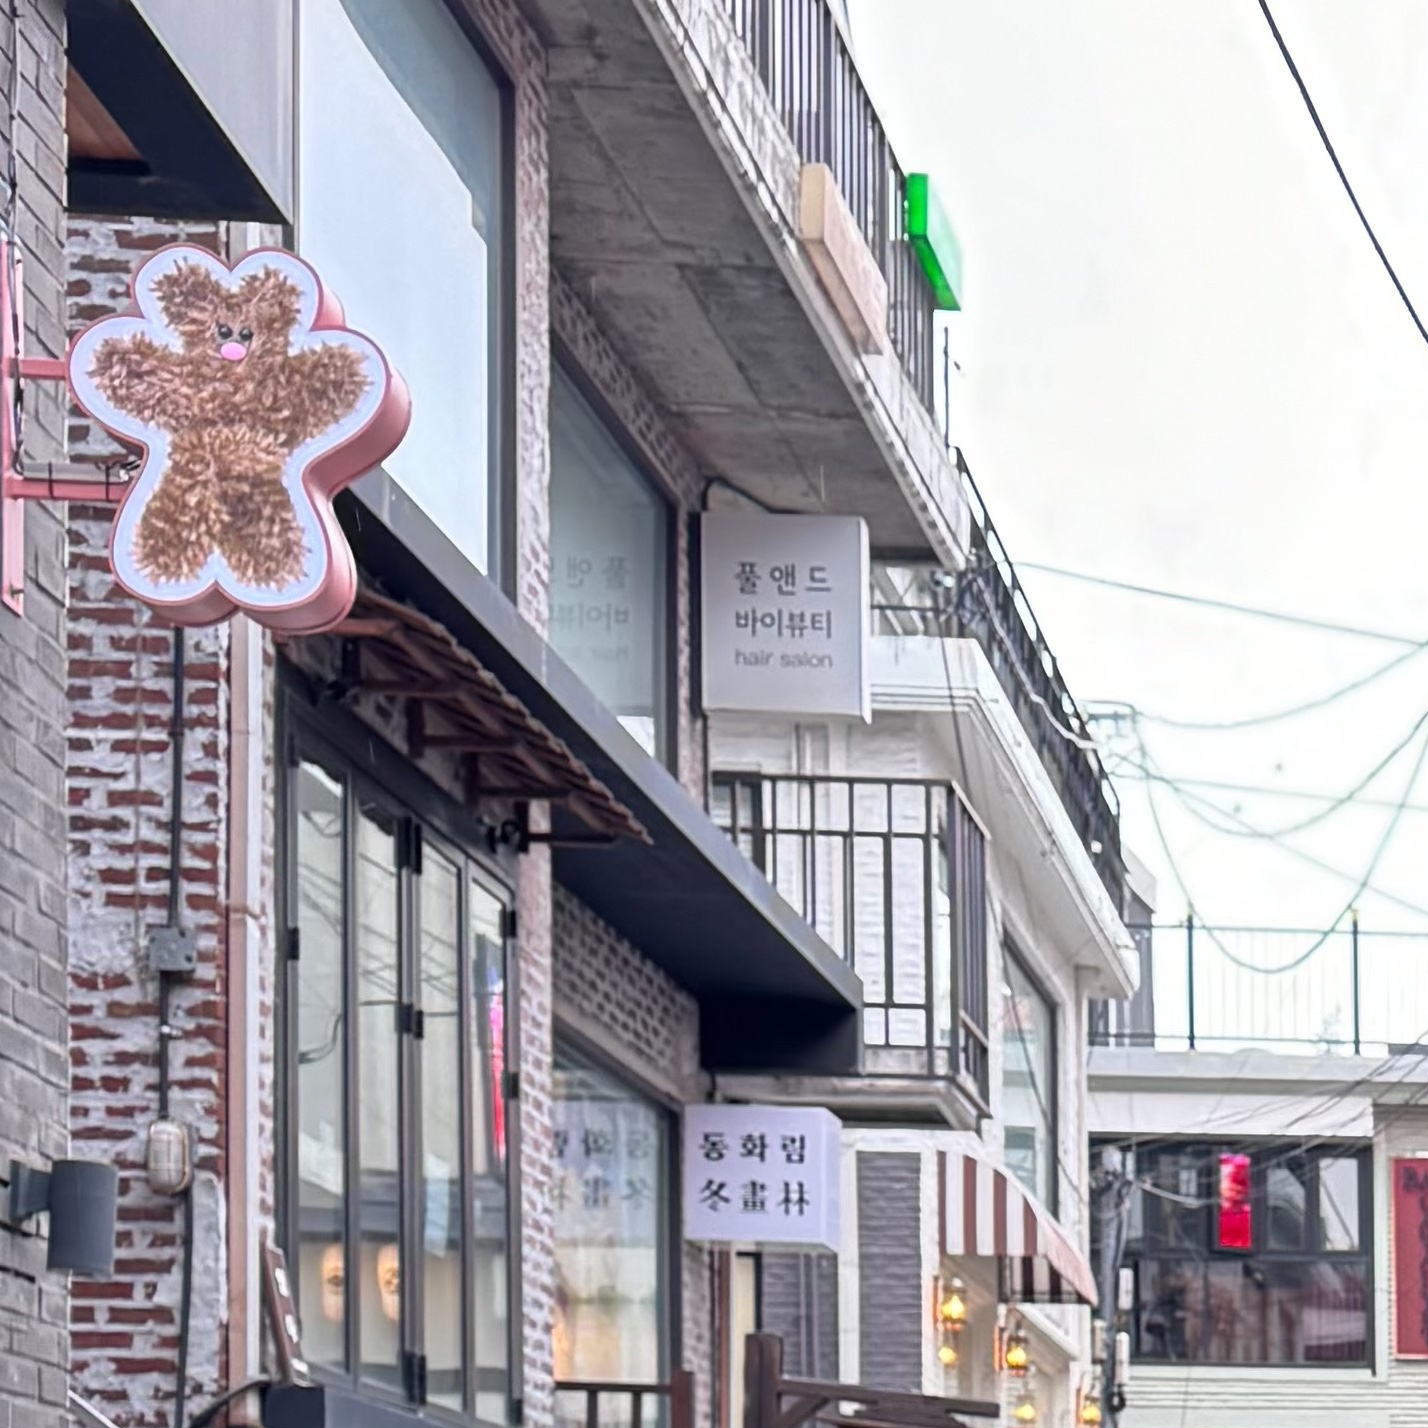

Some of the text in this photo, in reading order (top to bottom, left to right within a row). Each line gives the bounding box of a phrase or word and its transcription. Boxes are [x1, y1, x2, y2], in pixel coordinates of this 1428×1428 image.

[735, 607, 832, 639] 바이뷰티
[734, 649, 834, 669] hair salon
[699, 1131, 806, 1164] 동화림
